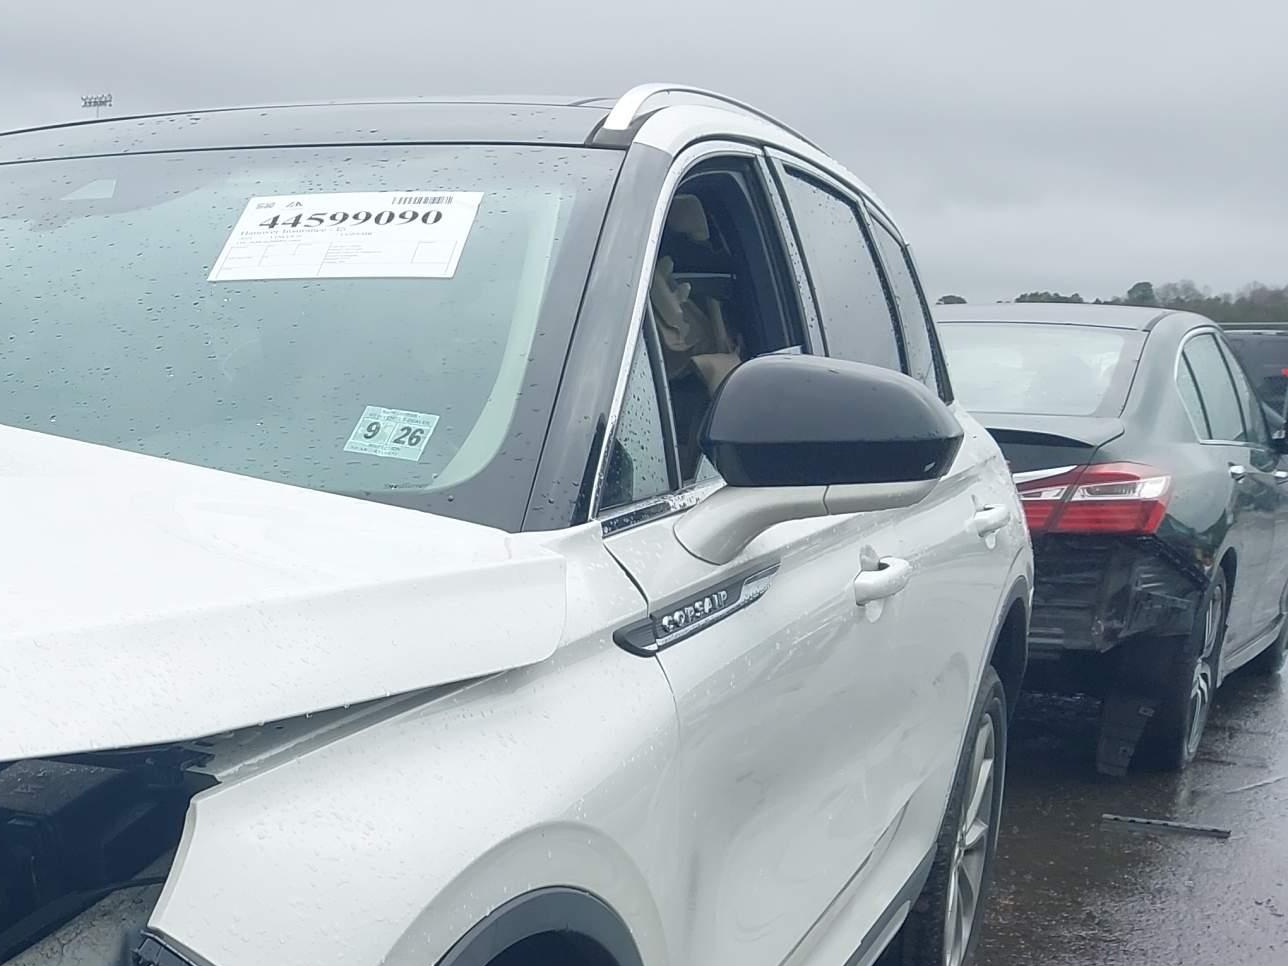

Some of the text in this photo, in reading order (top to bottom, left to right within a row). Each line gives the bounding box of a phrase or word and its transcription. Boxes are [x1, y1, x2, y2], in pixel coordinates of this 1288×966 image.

[258, 209, 443, 229] 44599090
[363, 421, 425, 447] 9 26
